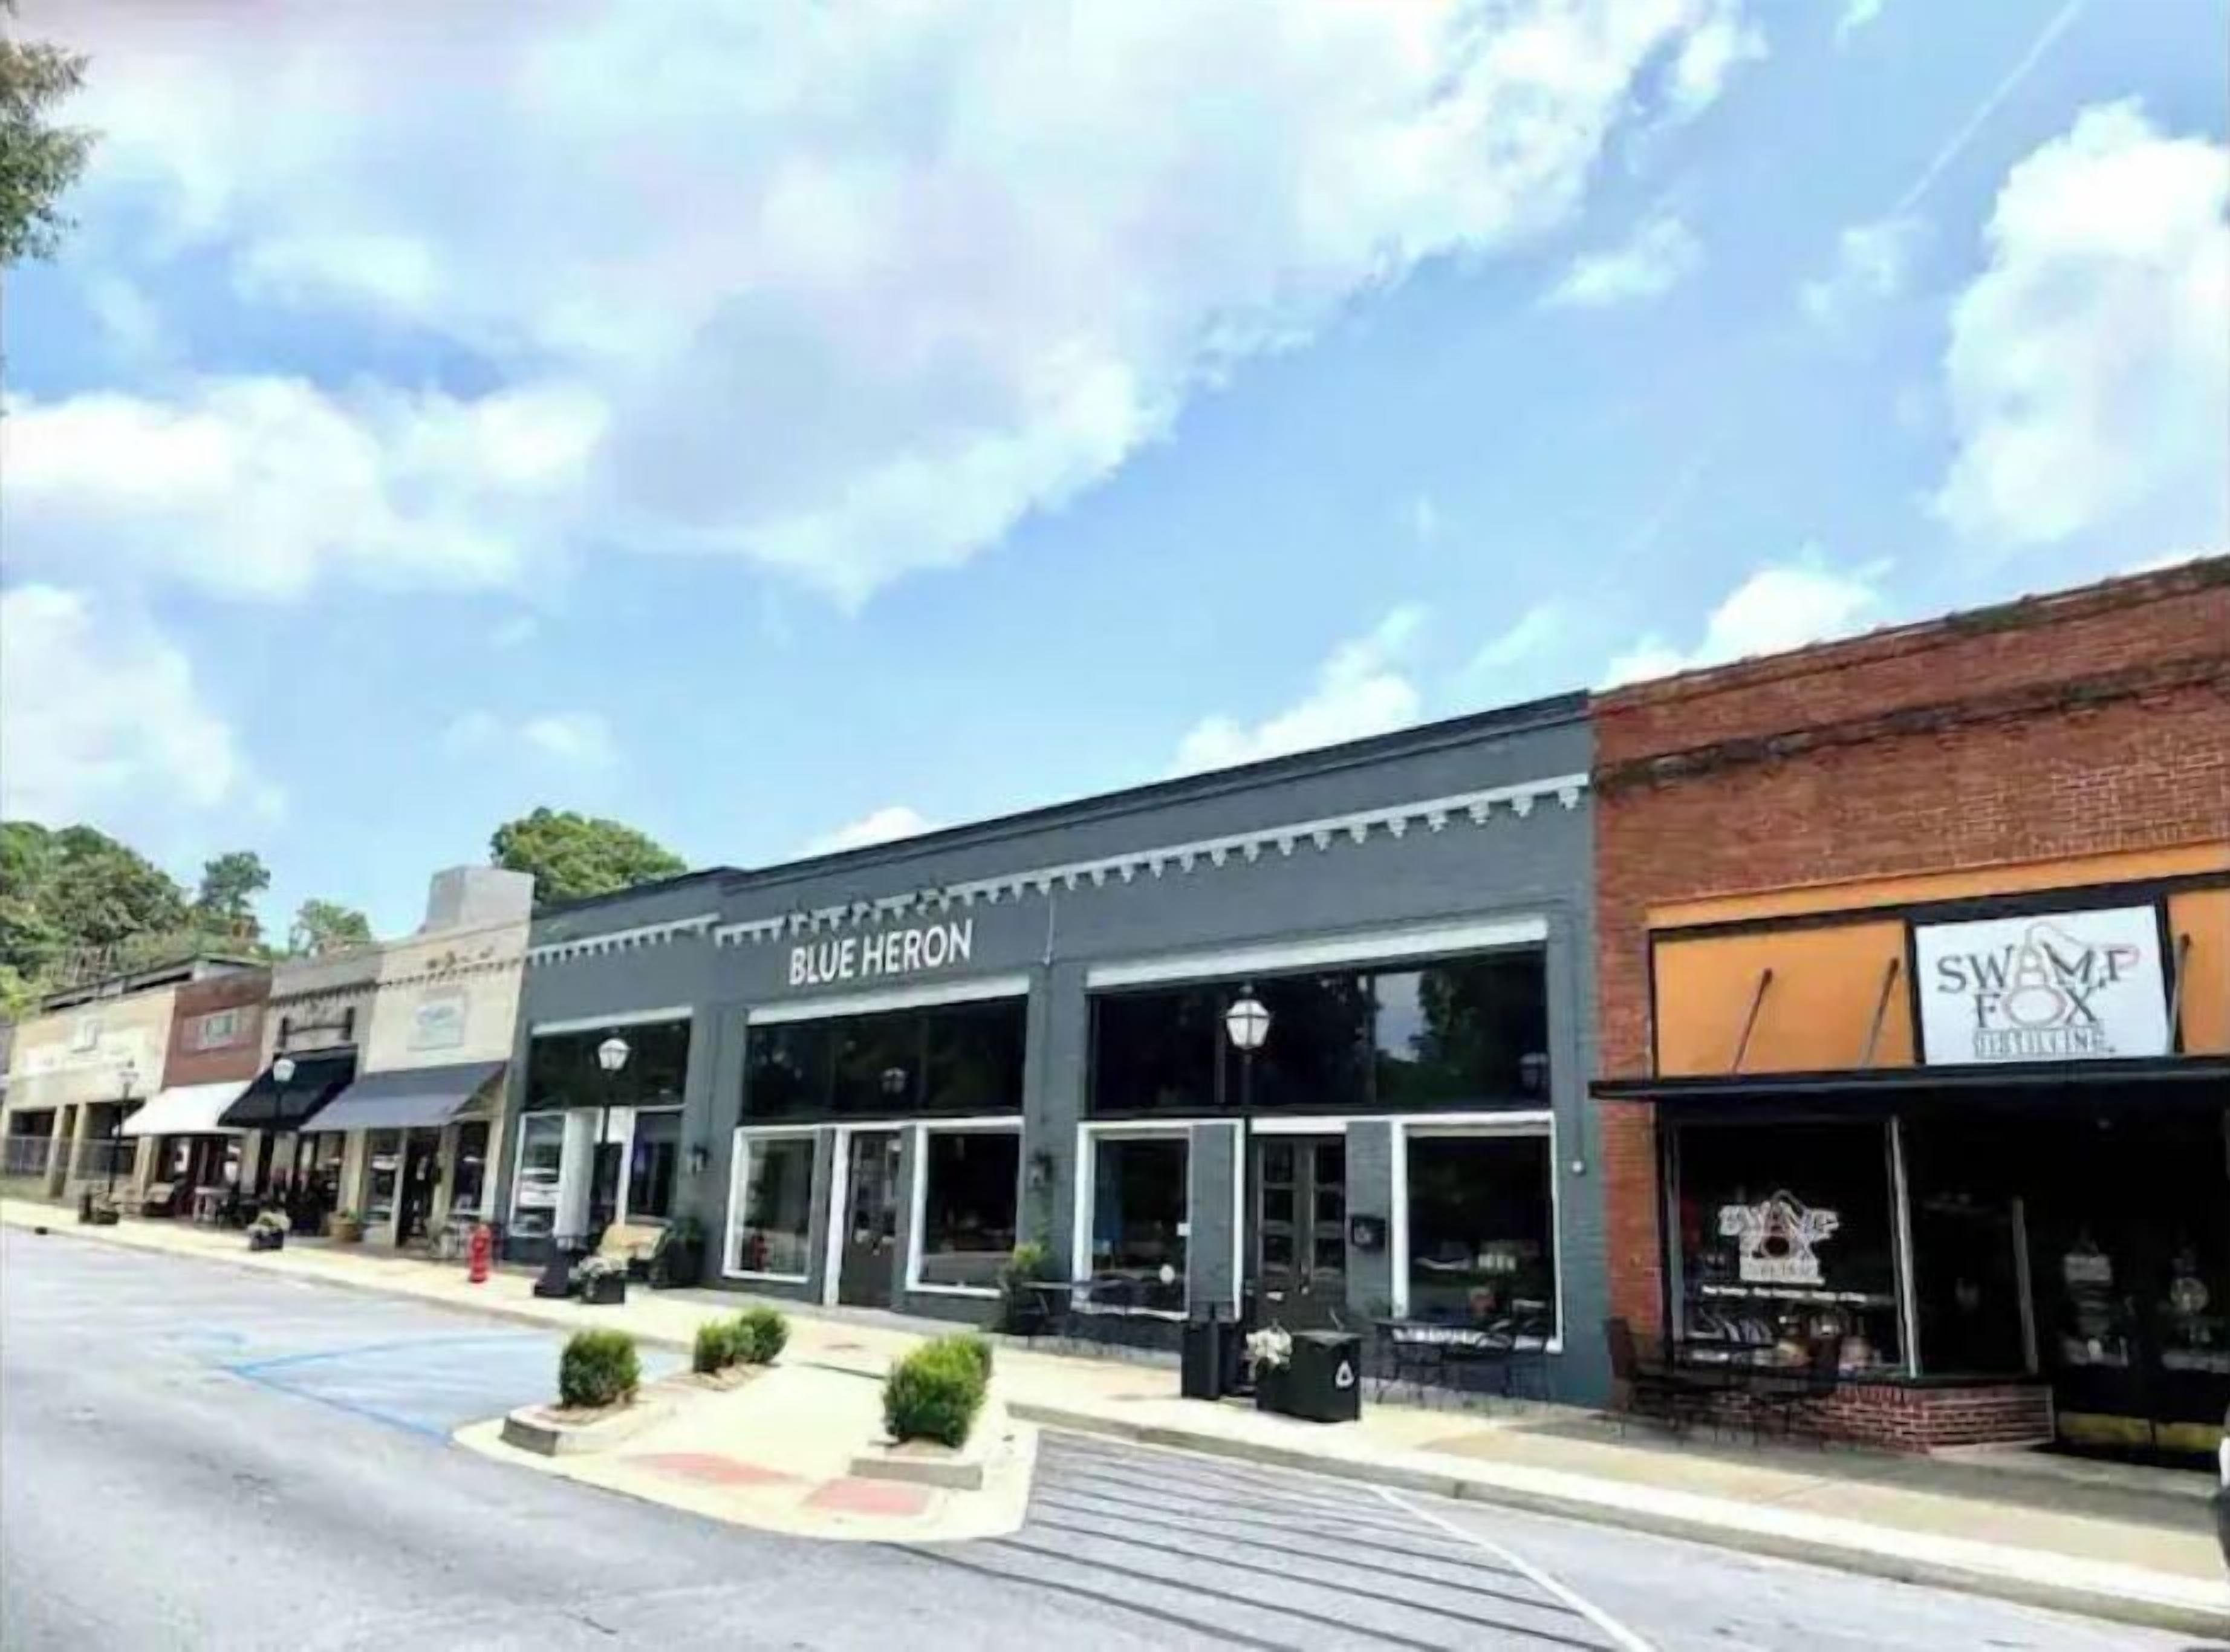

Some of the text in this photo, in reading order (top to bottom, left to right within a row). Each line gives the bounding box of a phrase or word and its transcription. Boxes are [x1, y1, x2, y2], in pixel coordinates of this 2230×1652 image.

[789, 918, 973, 985] BLUE HERON
[1937, 941, 2141, 993] SWAMP
[1974, 983, 2107, 1028] FOX
